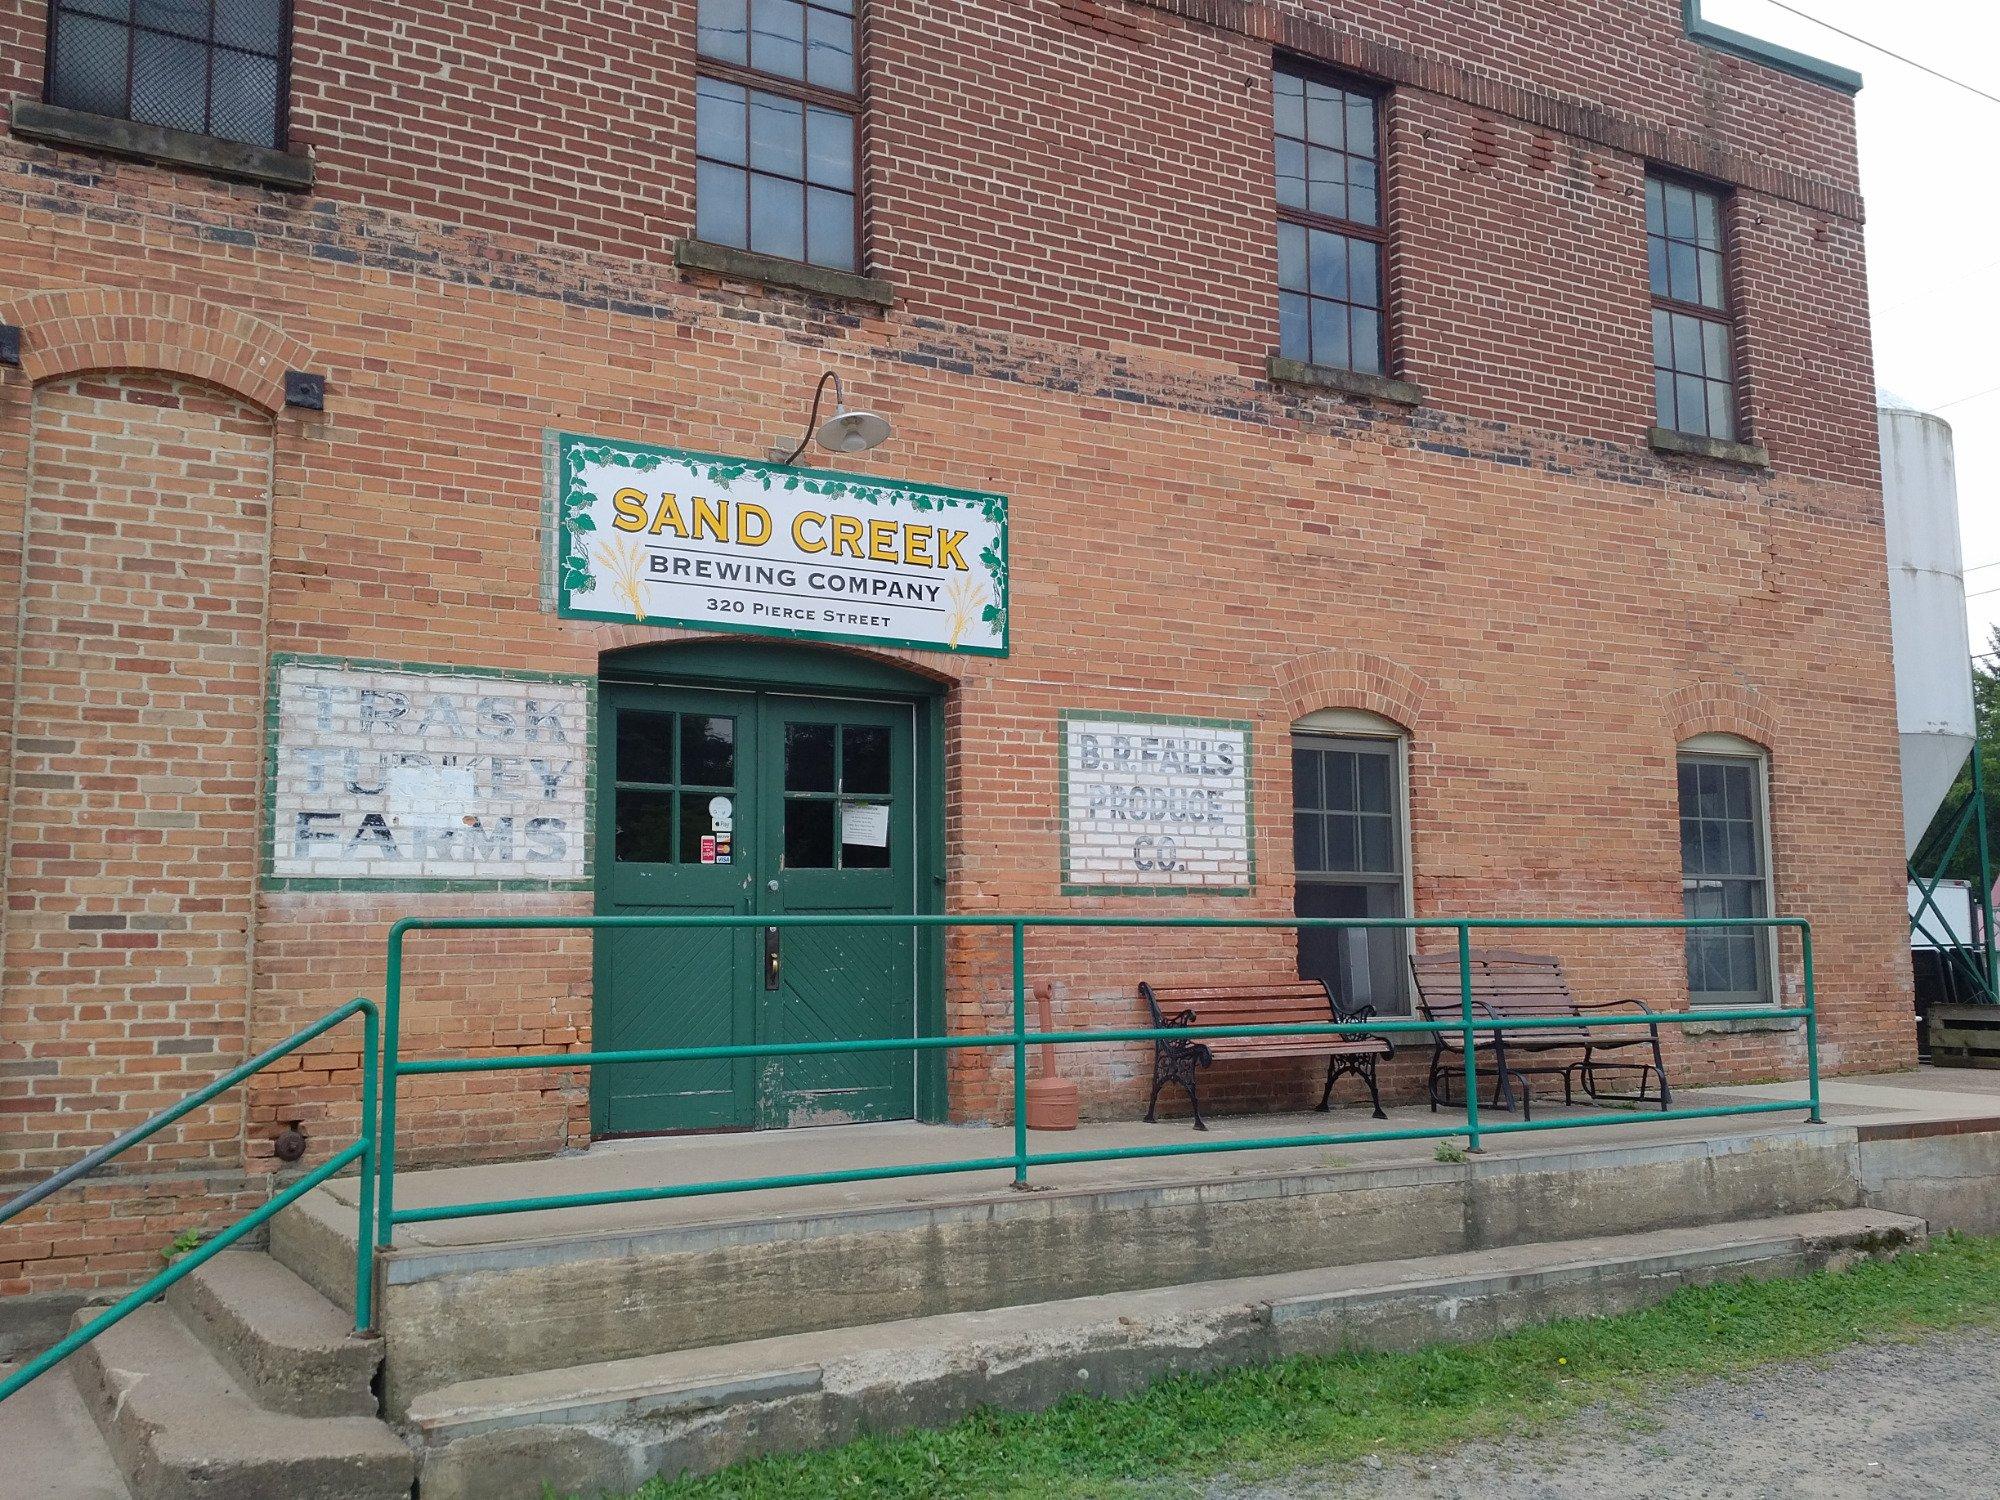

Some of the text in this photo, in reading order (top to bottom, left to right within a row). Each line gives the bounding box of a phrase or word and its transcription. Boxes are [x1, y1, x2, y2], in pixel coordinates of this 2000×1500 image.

[612, 487, 969, 571] SAND CREEK
[649, 555, 941, 602] BREWING COMPANY
[706, 598, 745, 613] 320
[300, 685, 568, 743] TRASK
[1090, 785, 1224, 822] PRODUCE
[1133, 836, 1185, 872] CO.
